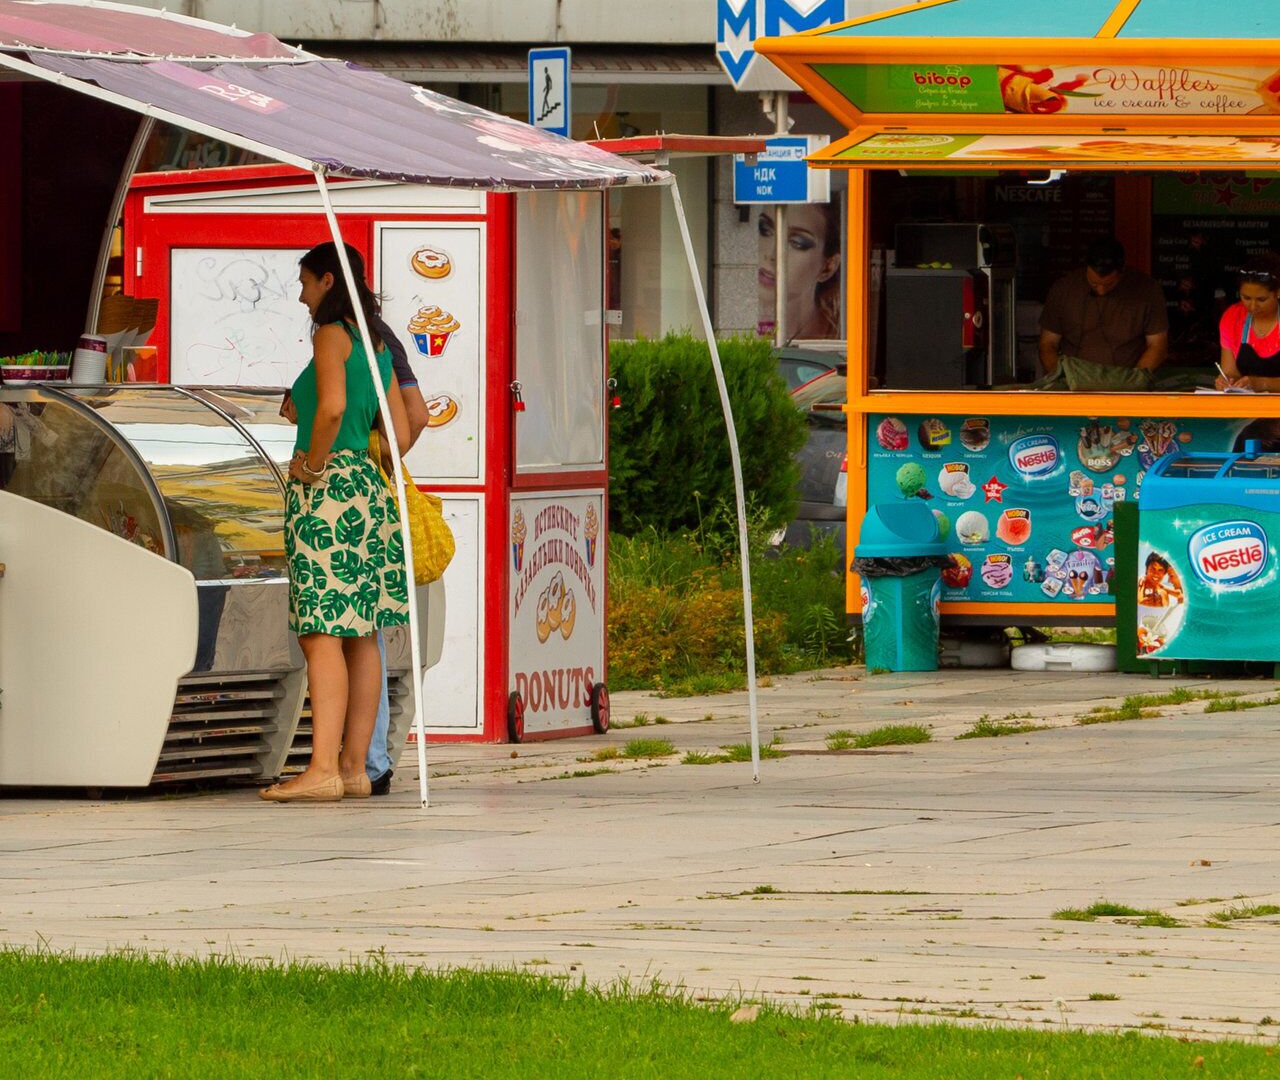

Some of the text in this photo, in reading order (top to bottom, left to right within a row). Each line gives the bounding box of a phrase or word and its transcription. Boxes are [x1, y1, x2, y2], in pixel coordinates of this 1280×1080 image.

[913, 71, 972, 89] bibop
[1092, 68, 1220, 99] Waffles
[1093, 95, 1247, 112] ice cream & coffee
[754, 168, 777, 182] НДК
[756, 185, 773, 196] NDK
[994, 184, 1062, 203] NESCAFÉ
[1088, 458, 1112, 466] BOSS
[535, 504, 577, 541] ИСТИНСКИТЕ
[1203, 527, 1251, 544] ICE CREAM
[515, 666, 595, 713] DONUTS
